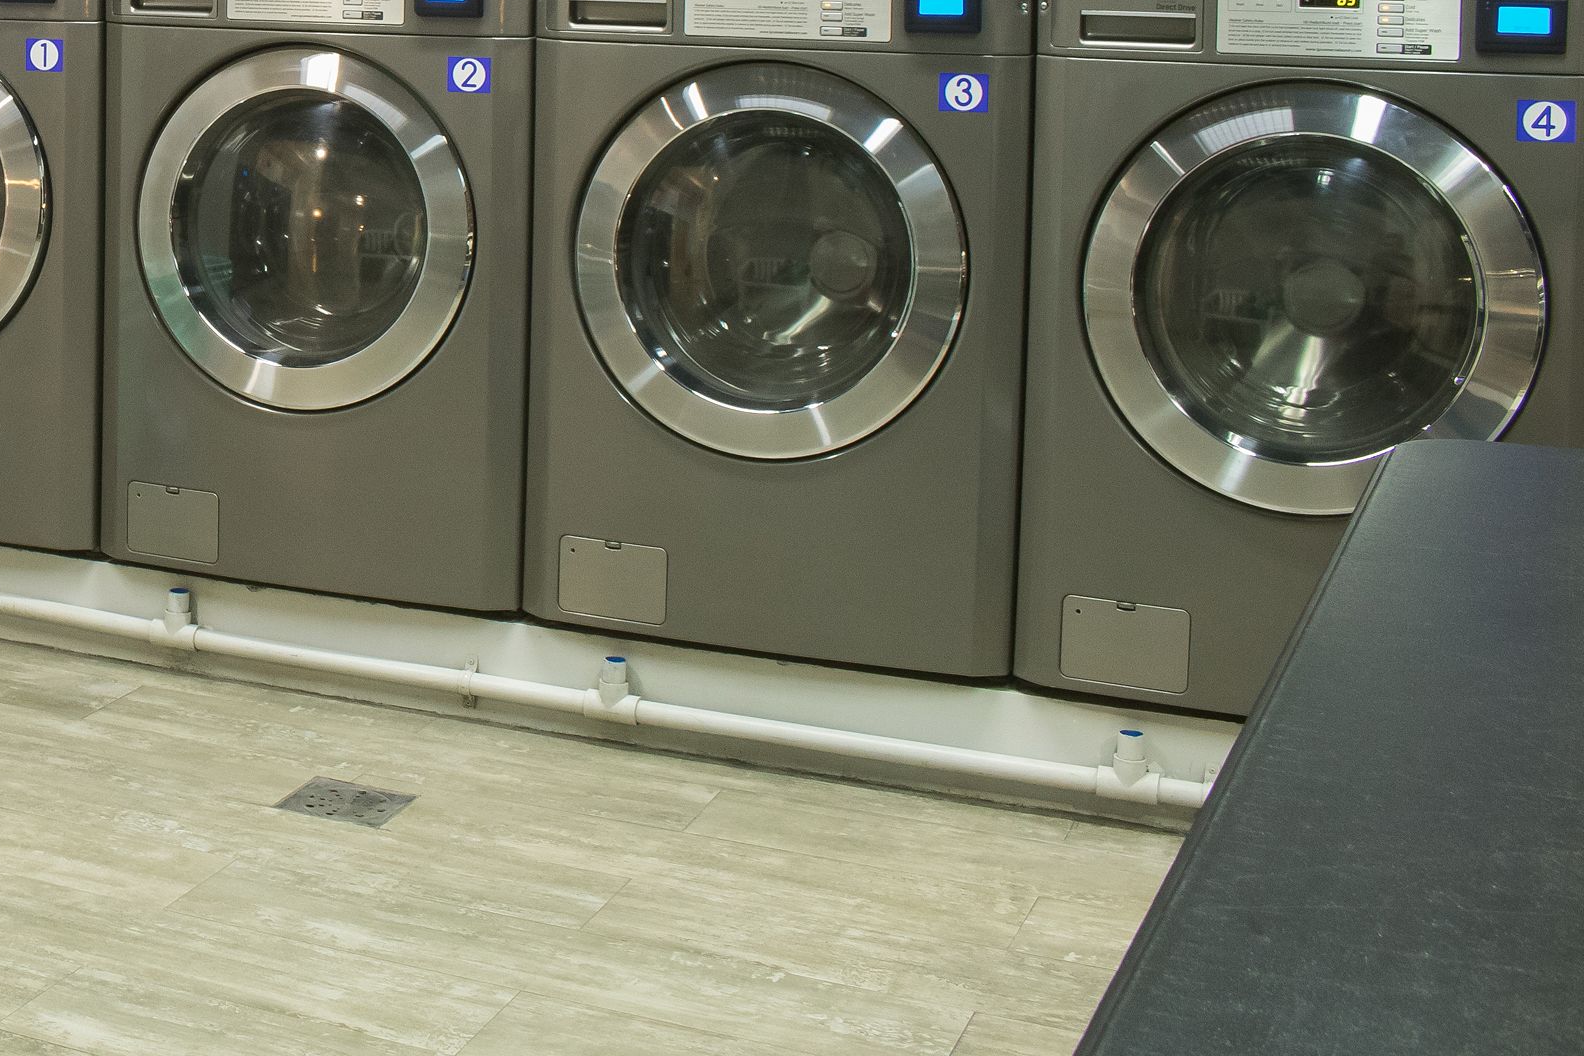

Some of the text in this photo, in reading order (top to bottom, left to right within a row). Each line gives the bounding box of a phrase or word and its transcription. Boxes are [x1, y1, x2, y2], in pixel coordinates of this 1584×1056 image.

[40, 43, 47, 68] 1
[461, 61, 477, 87] 2
[954, 77, 973, 106] 3
[1531, 105, 1556, 137] 4
